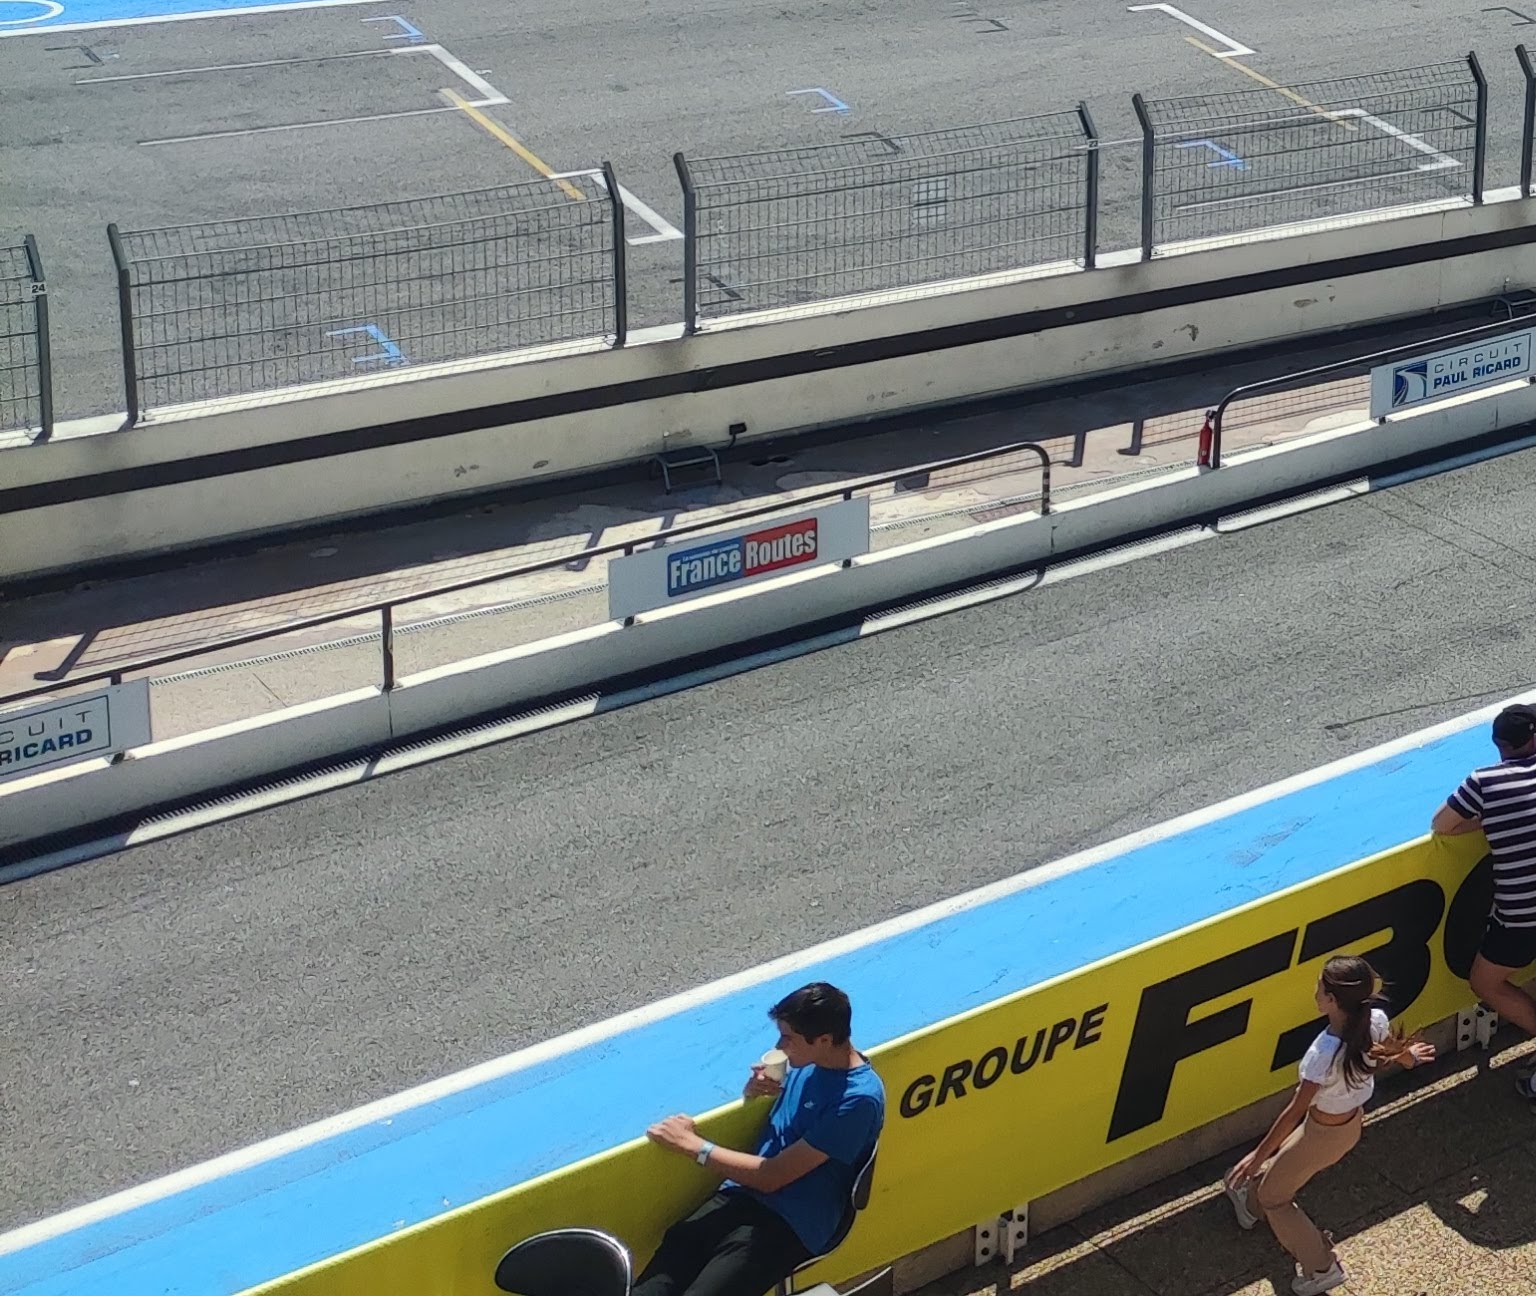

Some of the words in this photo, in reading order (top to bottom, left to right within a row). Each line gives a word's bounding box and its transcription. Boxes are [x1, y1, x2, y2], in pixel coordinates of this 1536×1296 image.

[1433, 370, 1468, 389] PAUL
[1472, 356, 1521, 378] RICARD
[1434, 342, 1522, 373] CIRCUIT
[671, 550, 742, 589] France
[745, 529, 816, 570] Routes
[0, 728, 93, 766] RICARD
[899, 1002, 1110, 1120] GROUPE
